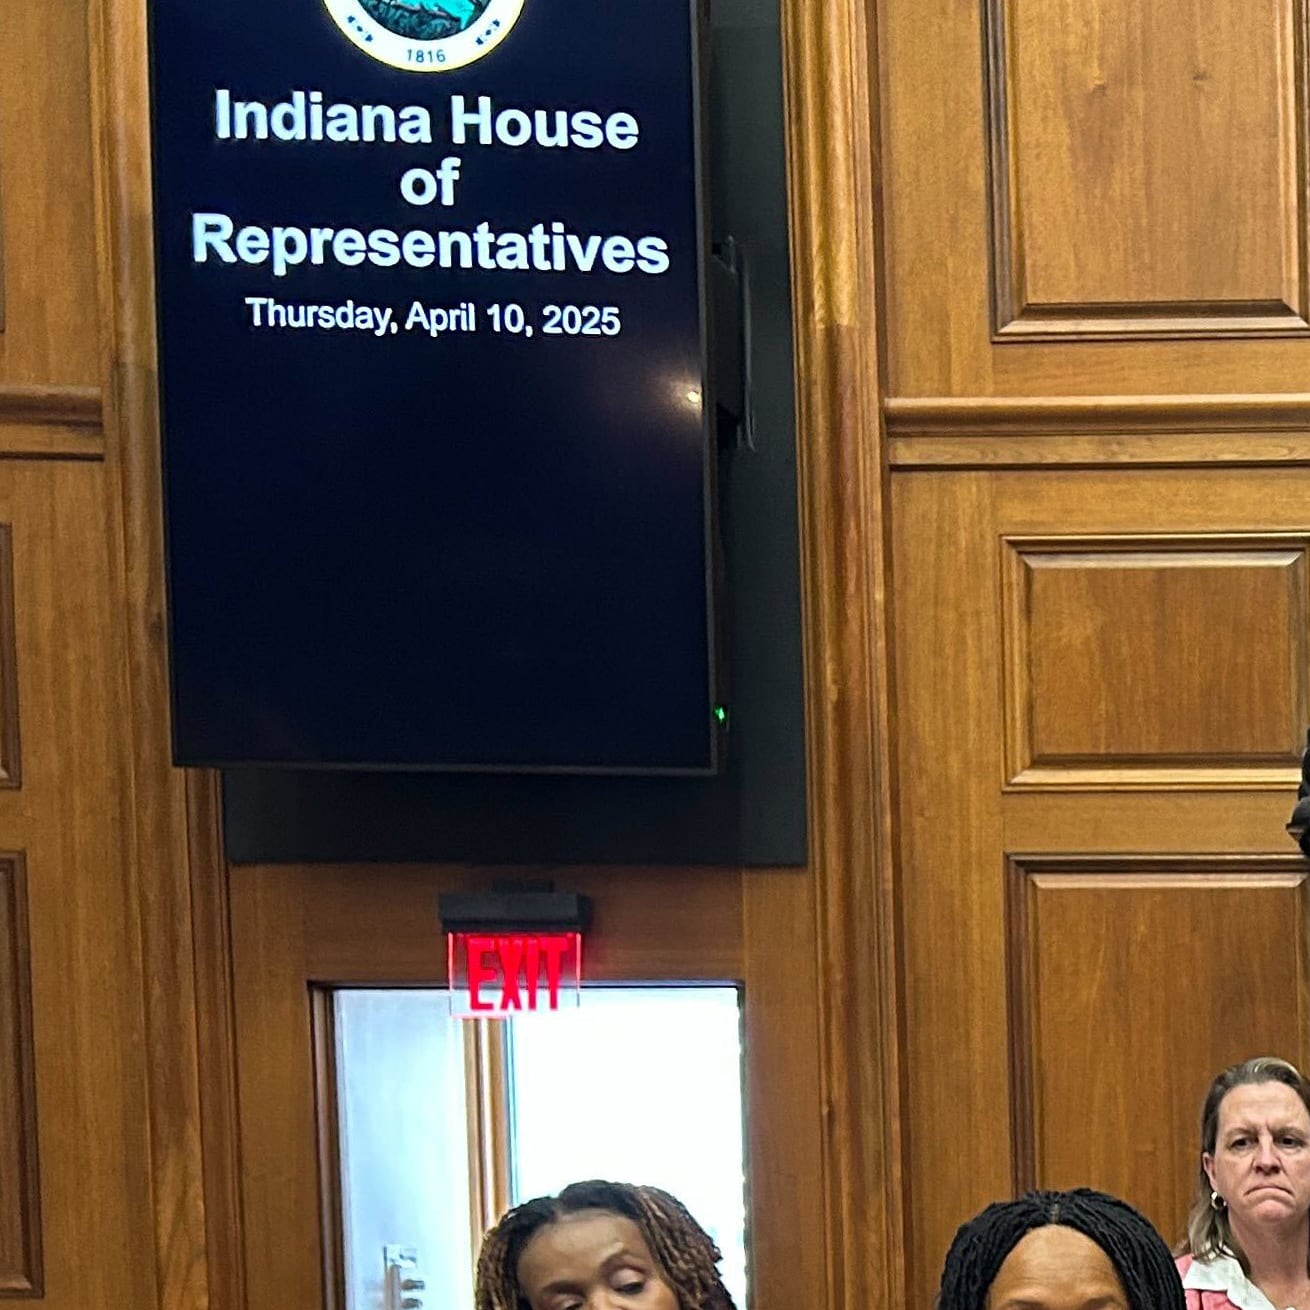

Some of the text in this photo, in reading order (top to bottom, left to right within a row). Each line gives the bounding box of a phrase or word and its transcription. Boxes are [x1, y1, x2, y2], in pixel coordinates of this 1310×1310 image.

[407, 48, 446, 64] 1816
[214, 88, 641, 150] Indiana House
[400, 156, 462, 207] of
[191, 211, 672, 277] Representatives
[244, 296, 621, 337] Thursday, April 10, 2025
[466, 936, 569, 1011] EXIT
